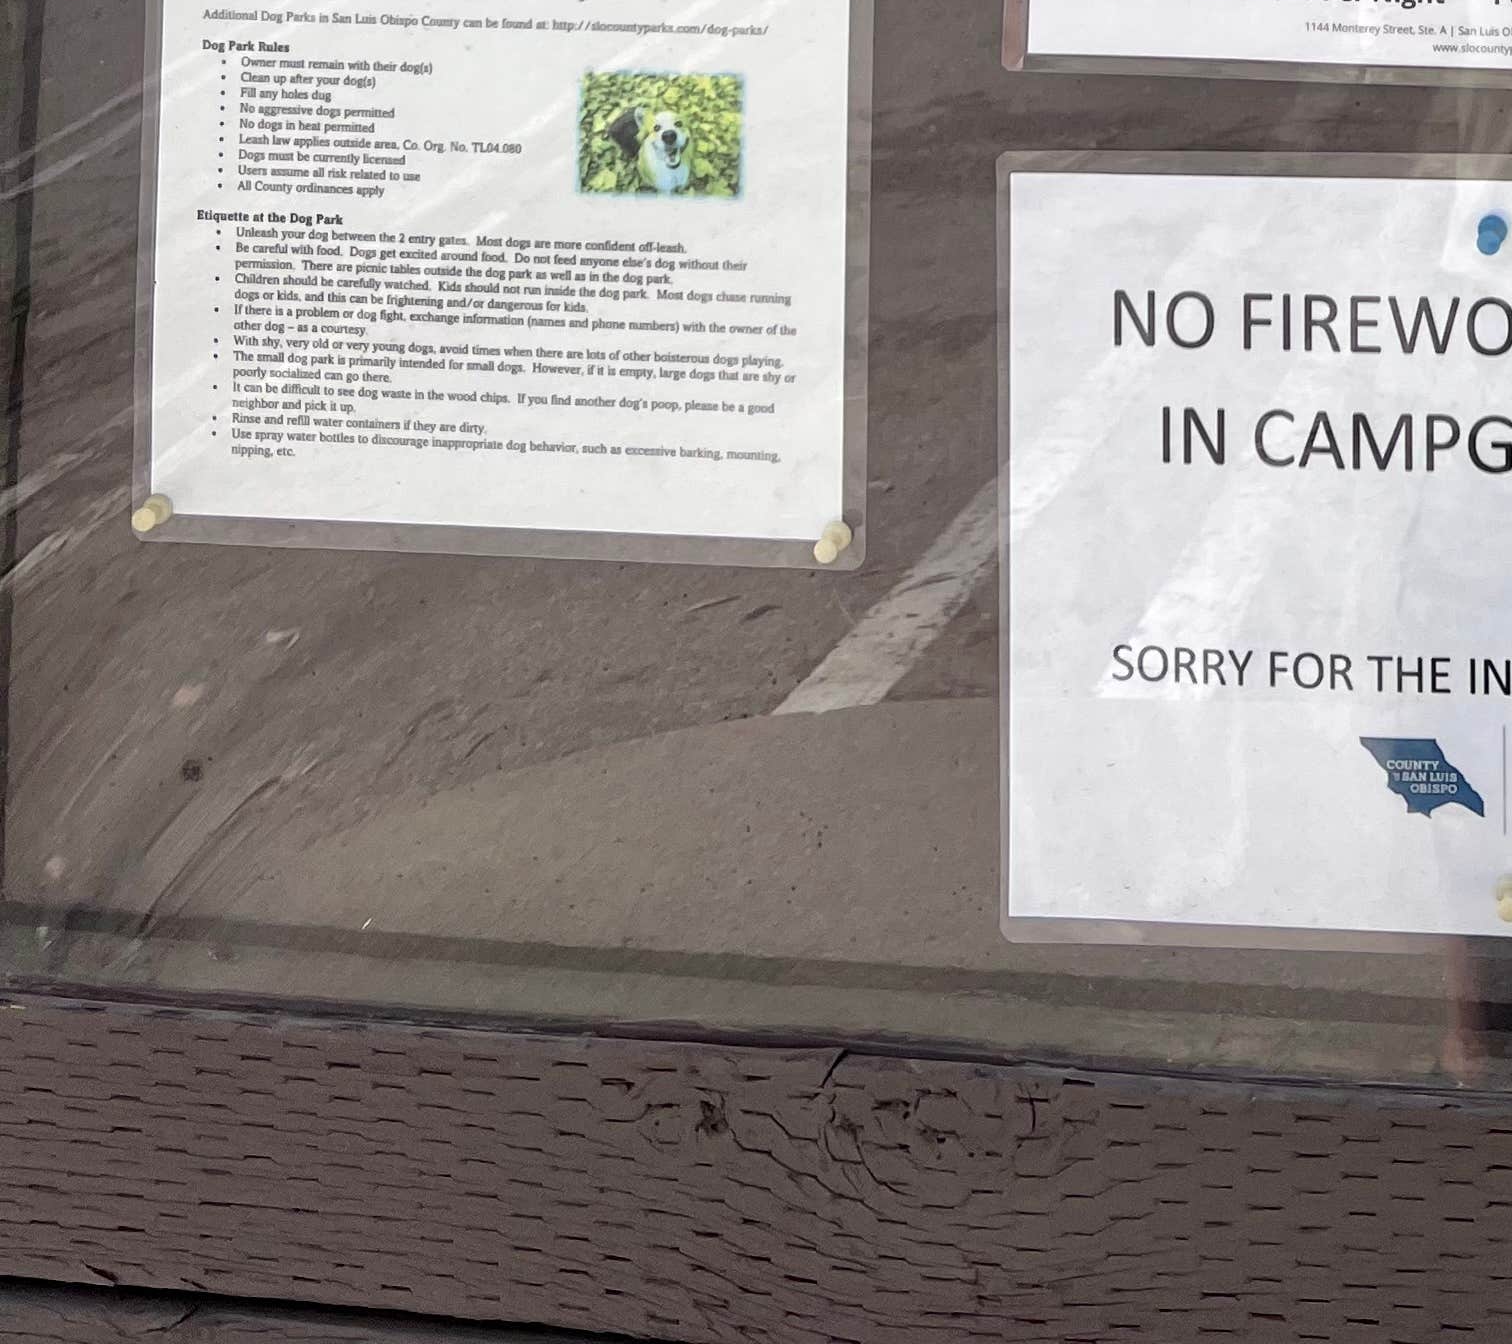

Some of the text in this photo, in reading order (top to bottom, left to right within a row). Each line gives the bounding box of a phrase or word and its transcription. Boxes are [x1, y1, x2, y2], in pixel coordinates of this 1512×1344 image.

[202, 39, 290, 54] Dog Park Rules
[239, 86, 332, 104] Fill any holes dug
[196, 209, 344, 227] Etiquette at the Dog Park
[1113, 289, 1215, 349] NO
[1162, 406, 1225, 466] IN
[1112, 644, 1253, 687] SORRY
[1269, 651, 1353, 691] FOR
[1366, 655, 1451, 694] THE
